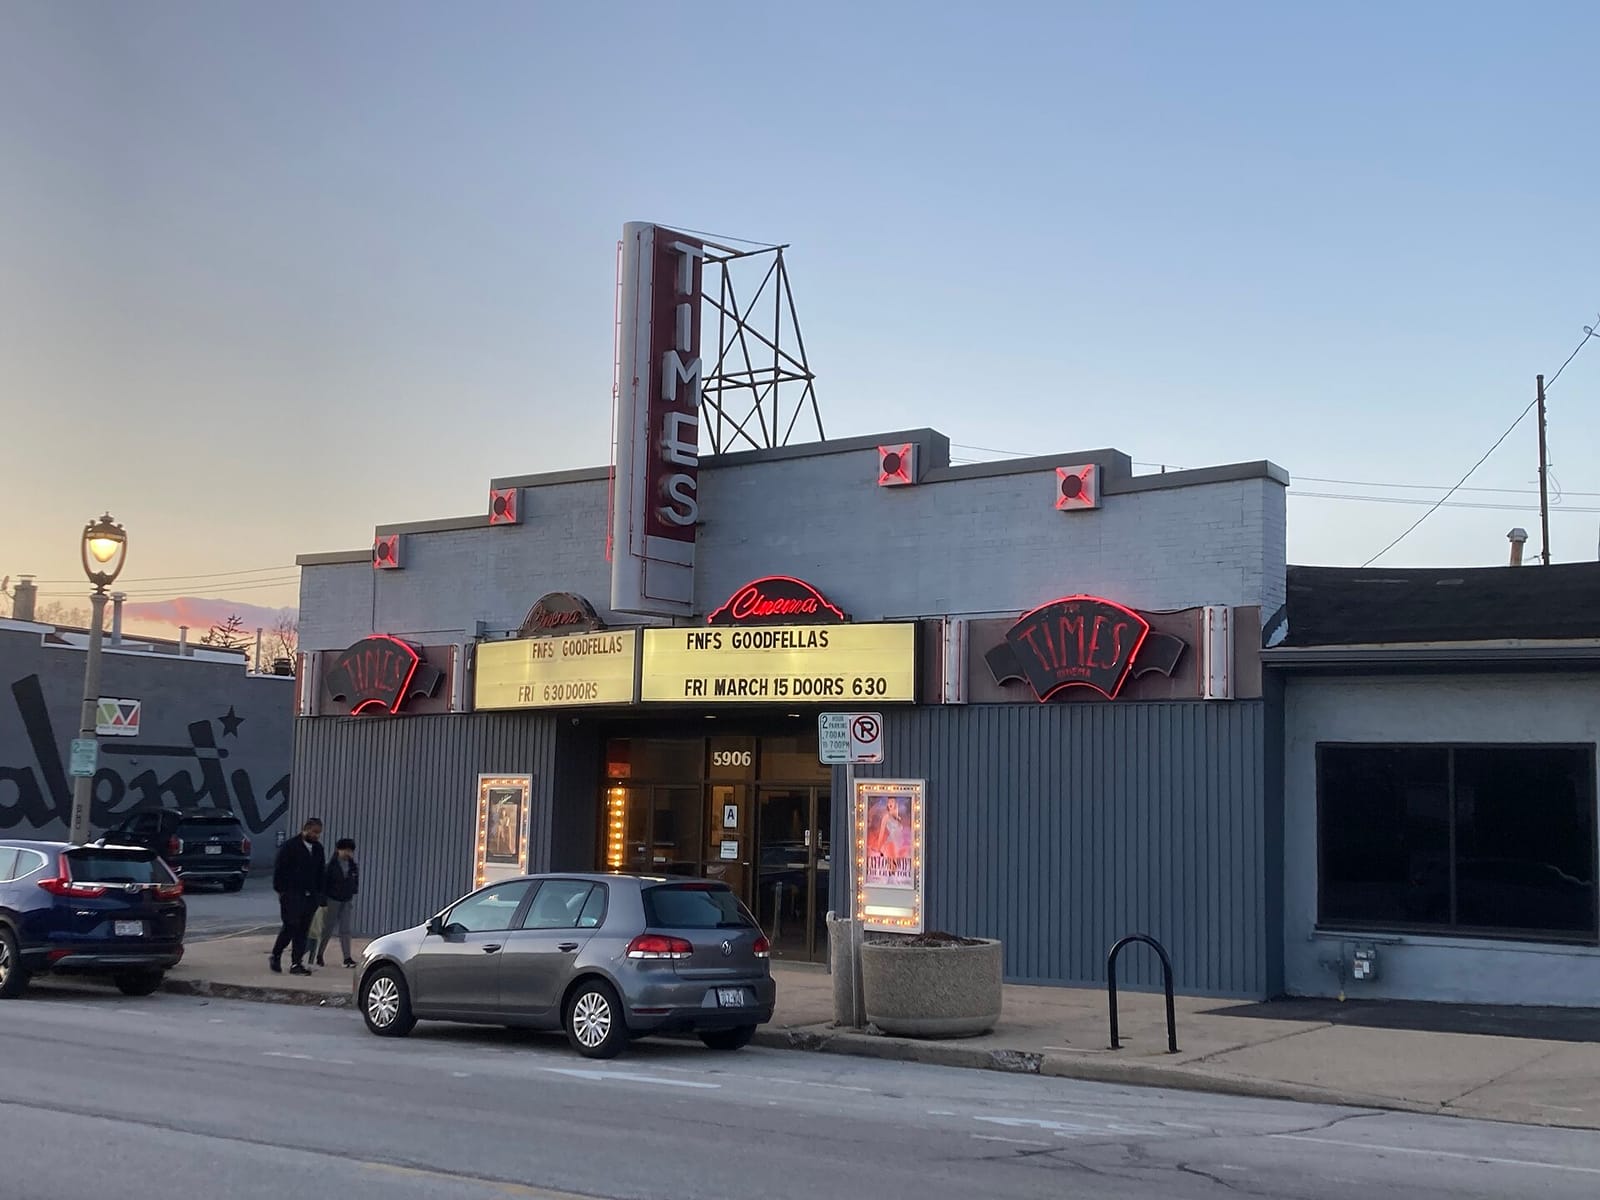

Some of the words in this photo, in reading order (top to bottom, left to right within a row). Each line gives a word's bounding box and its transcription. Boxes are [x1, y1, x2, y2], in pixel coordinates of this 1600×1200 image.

[660, 241, 703, 526] TIMES
[732, 587, 818, 619] Cinema
[532, 642, 554, 659] FNFS
[562, 636, 623, 657] GOODFELLAS
[686, 632, 722, 650] FNFS
[731, 630, 829, 649] GOODFELLAS
[1017, 615, 1128, 672] TIMES
[518, 685, 535, 702] FRI
[566, 682, 598, 700] DOORS
[684, 678, 708, 696] FRI
[714, 678, 769, 696] MARCH
[773, 678, 789, 696] 15
[792, 678, 844, 696] DOORS
[852, 677, 888, 695] 630
[822, 716, 828, 729] 2
[713, 751, 751, 766] 5906
[727, 809, 735, 820] A
